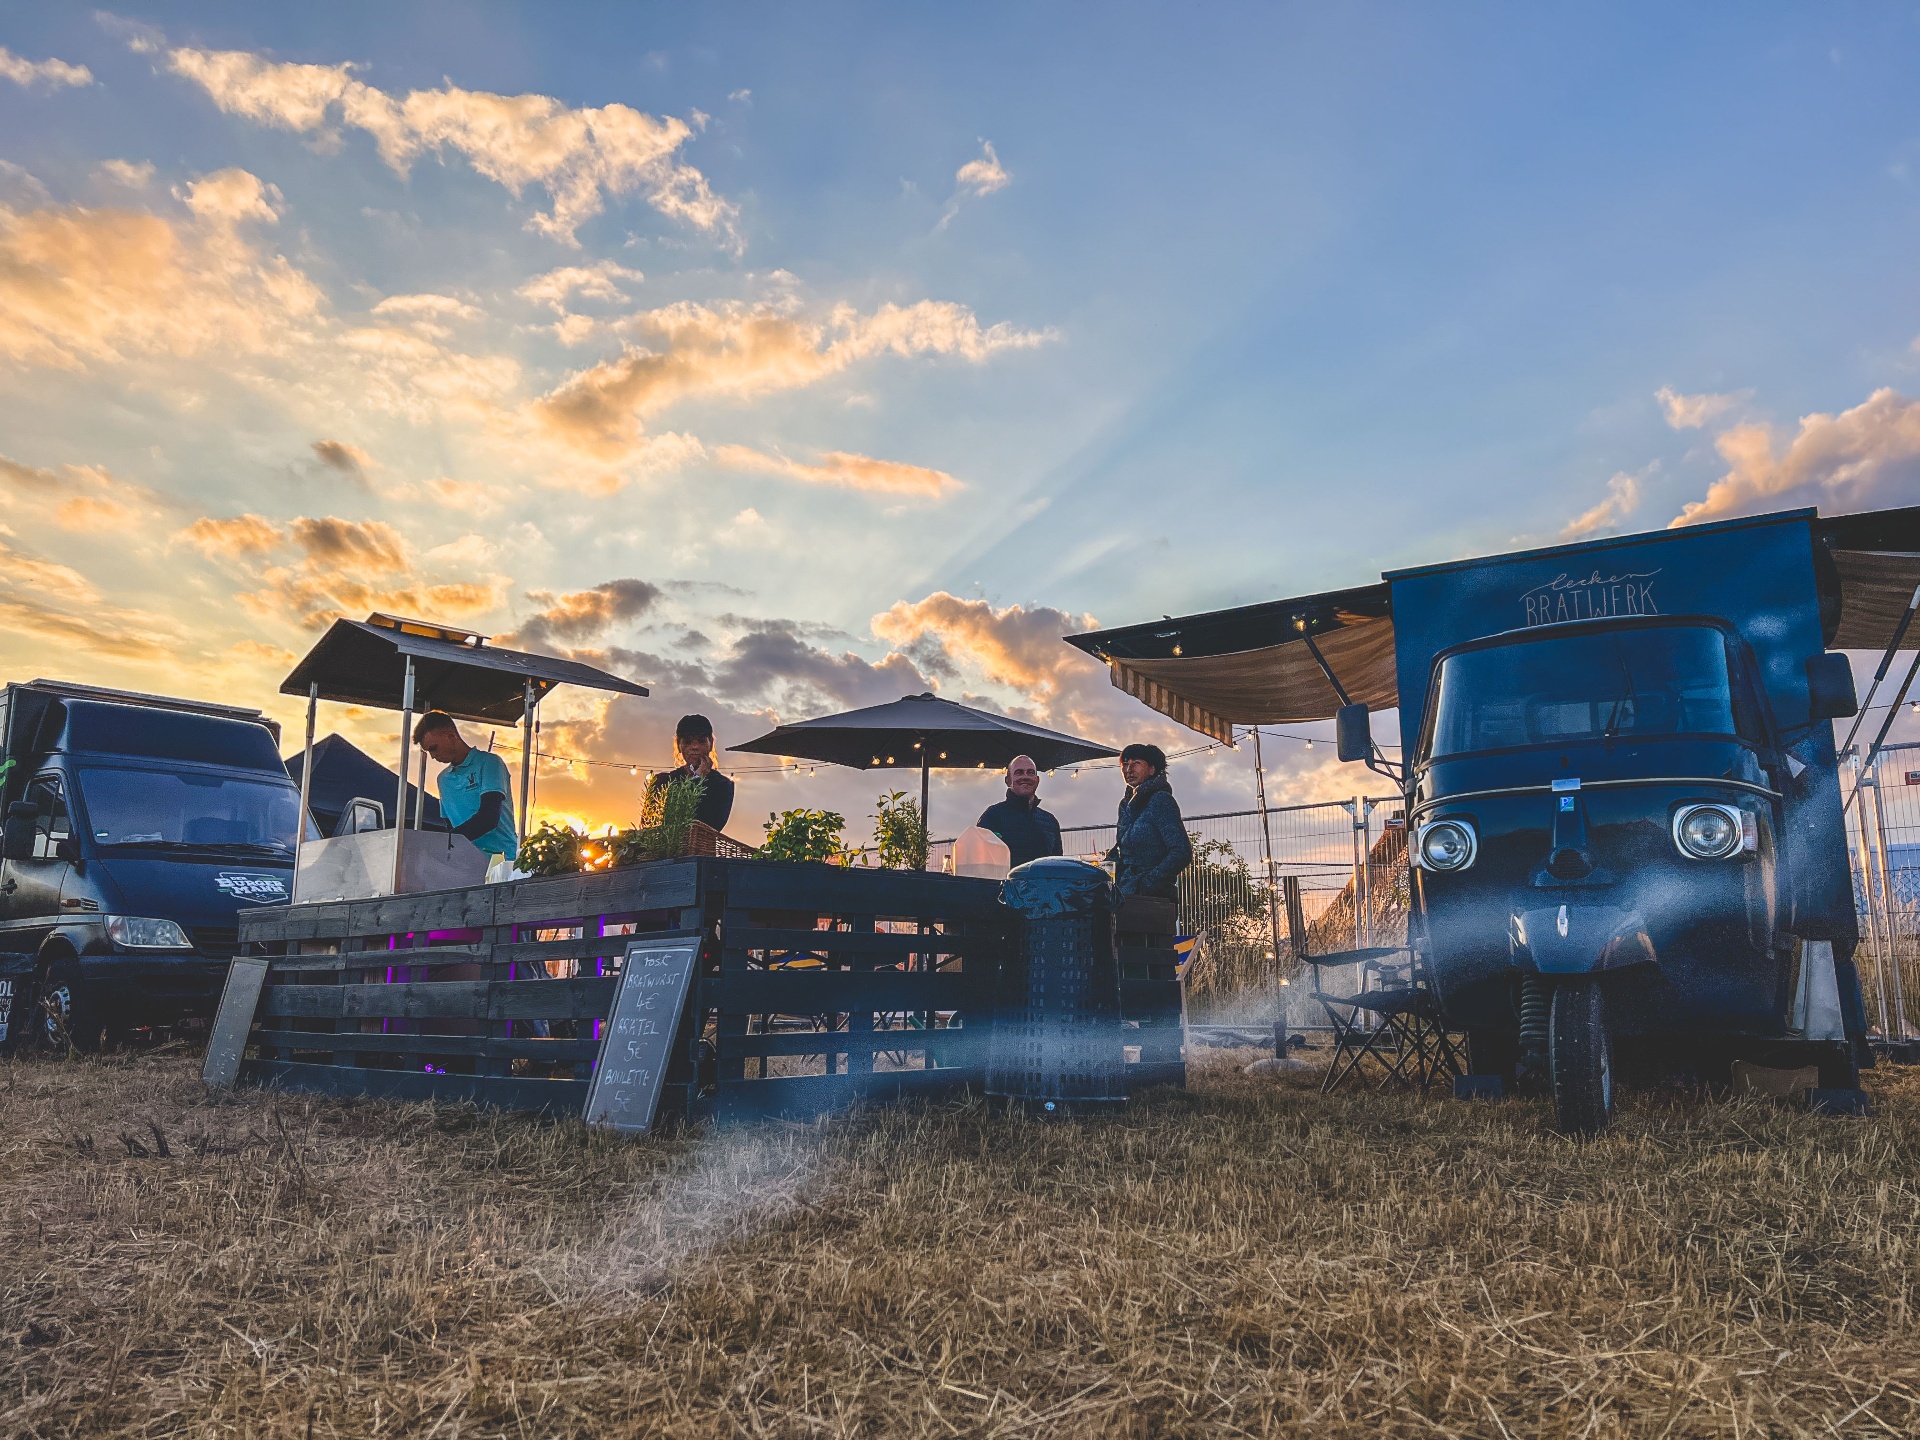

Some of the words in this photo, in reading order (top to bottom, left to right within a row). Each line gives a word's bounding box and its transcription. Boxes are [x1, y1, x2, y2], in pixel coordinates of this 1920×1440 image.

[627, 973, 680, 988] BRATWURST
[636, 991, 660, 1011] 4€
[623, 1040, 648, 1063] 5€
